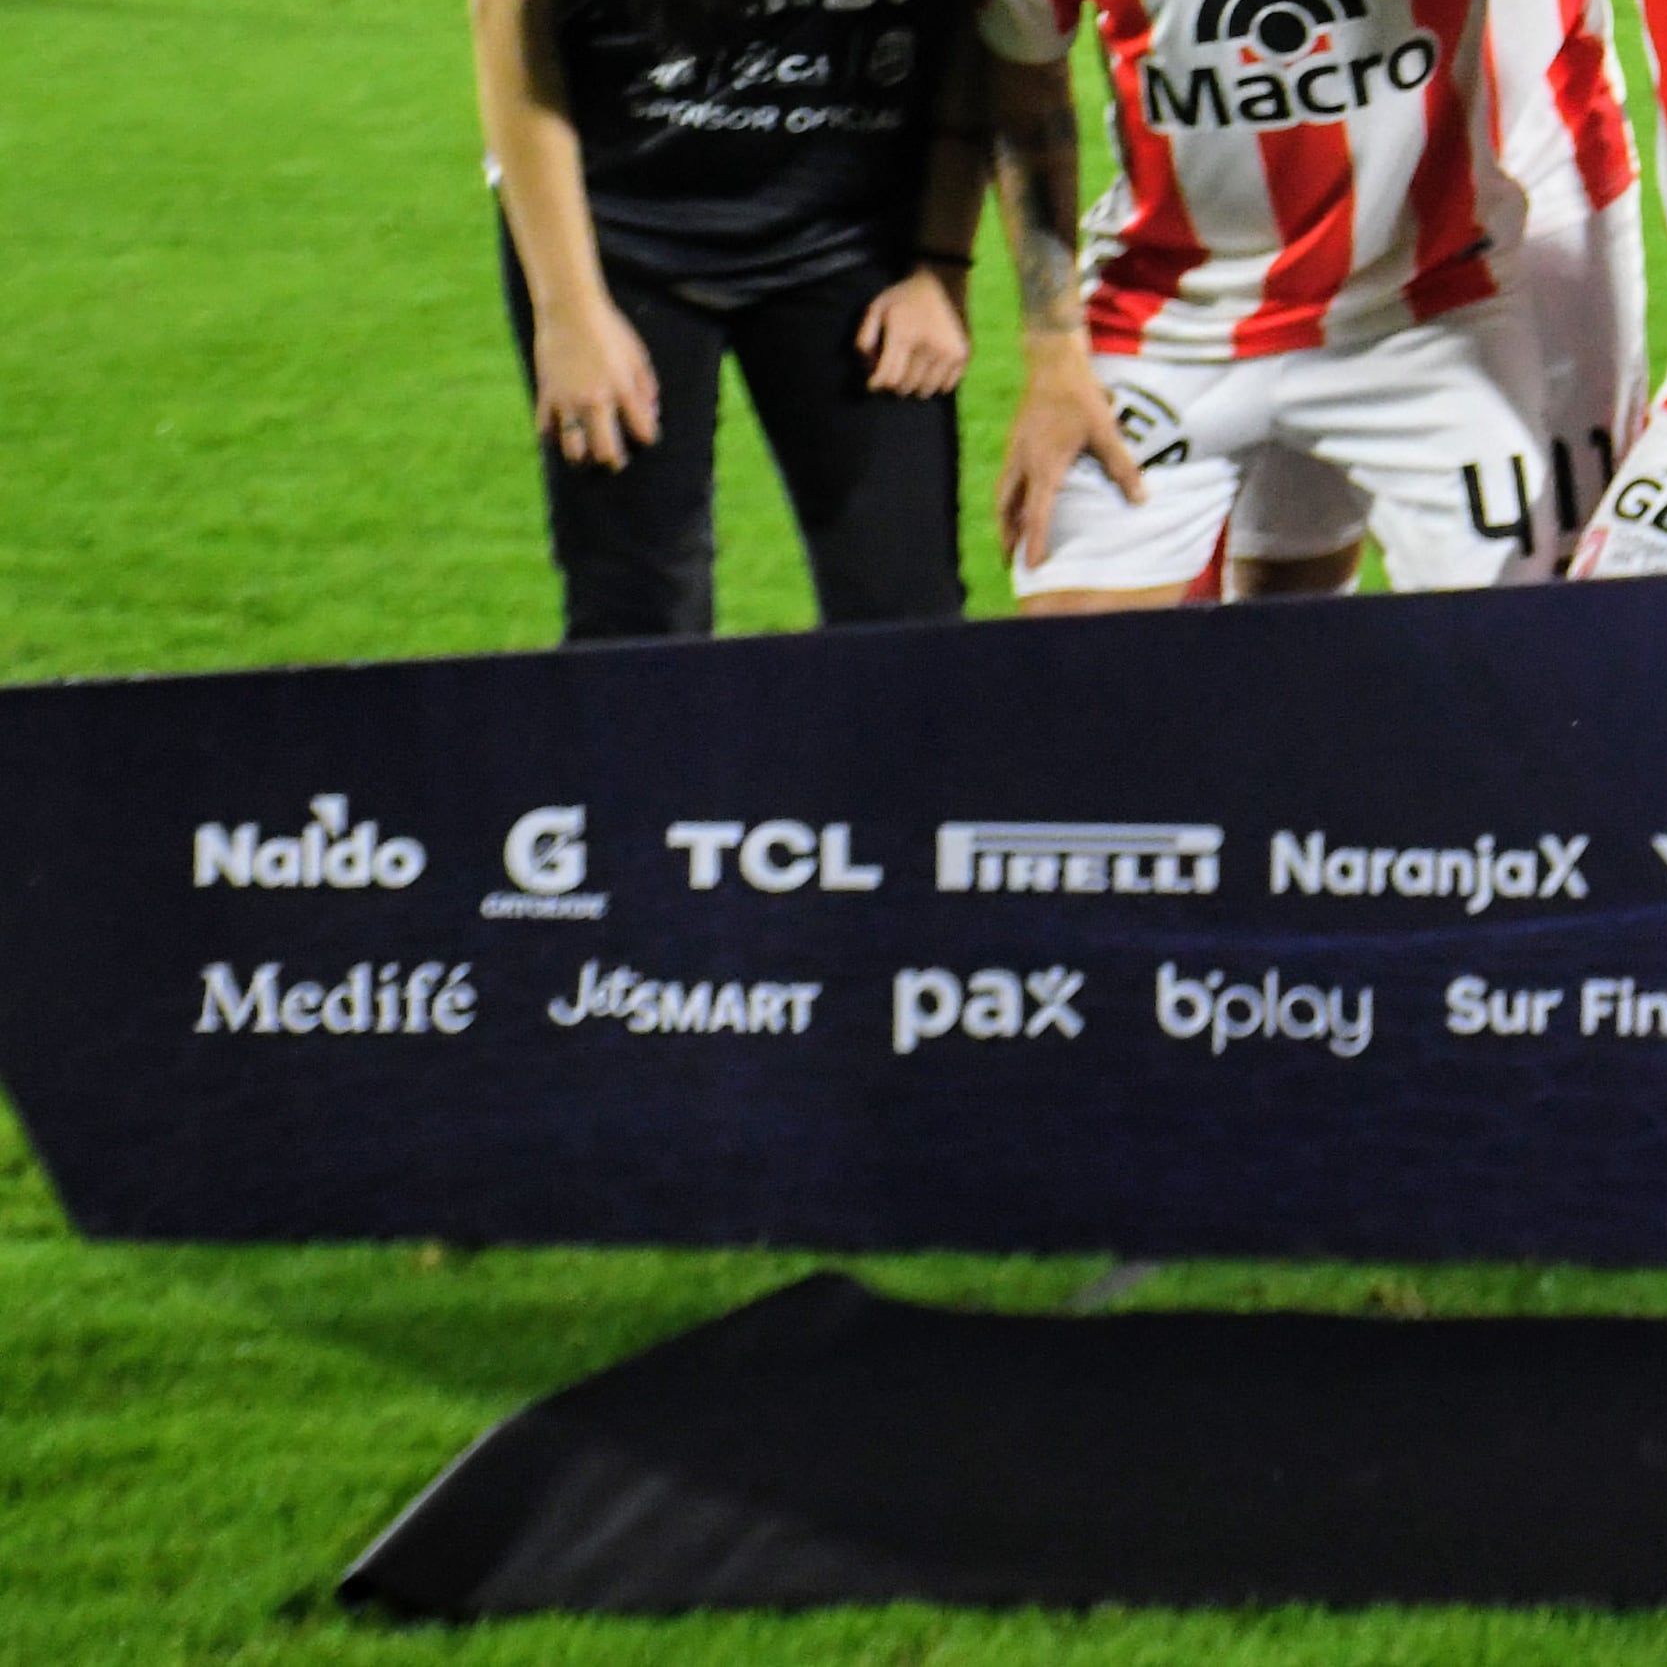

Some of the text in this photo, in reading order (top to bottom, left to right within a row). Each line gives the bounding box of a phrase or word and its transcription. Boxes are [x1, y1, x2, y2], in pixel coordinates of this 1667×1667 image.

[1144, 35, 1438, 129] Macro
[193, 808, 427, 889] Naldo
[665, 819, 883, 892] TCL
[936, 821, 1225, 894] PIRELLI
[1270, 830, 1591, 916] NaranjaX
[193, 961, 479, 1036] Medifé
[548, 959, 823, 1037] JetSMART
[892, 965, 1086, 1056] pax
[1444, 974, 1565, 1036] Sur
